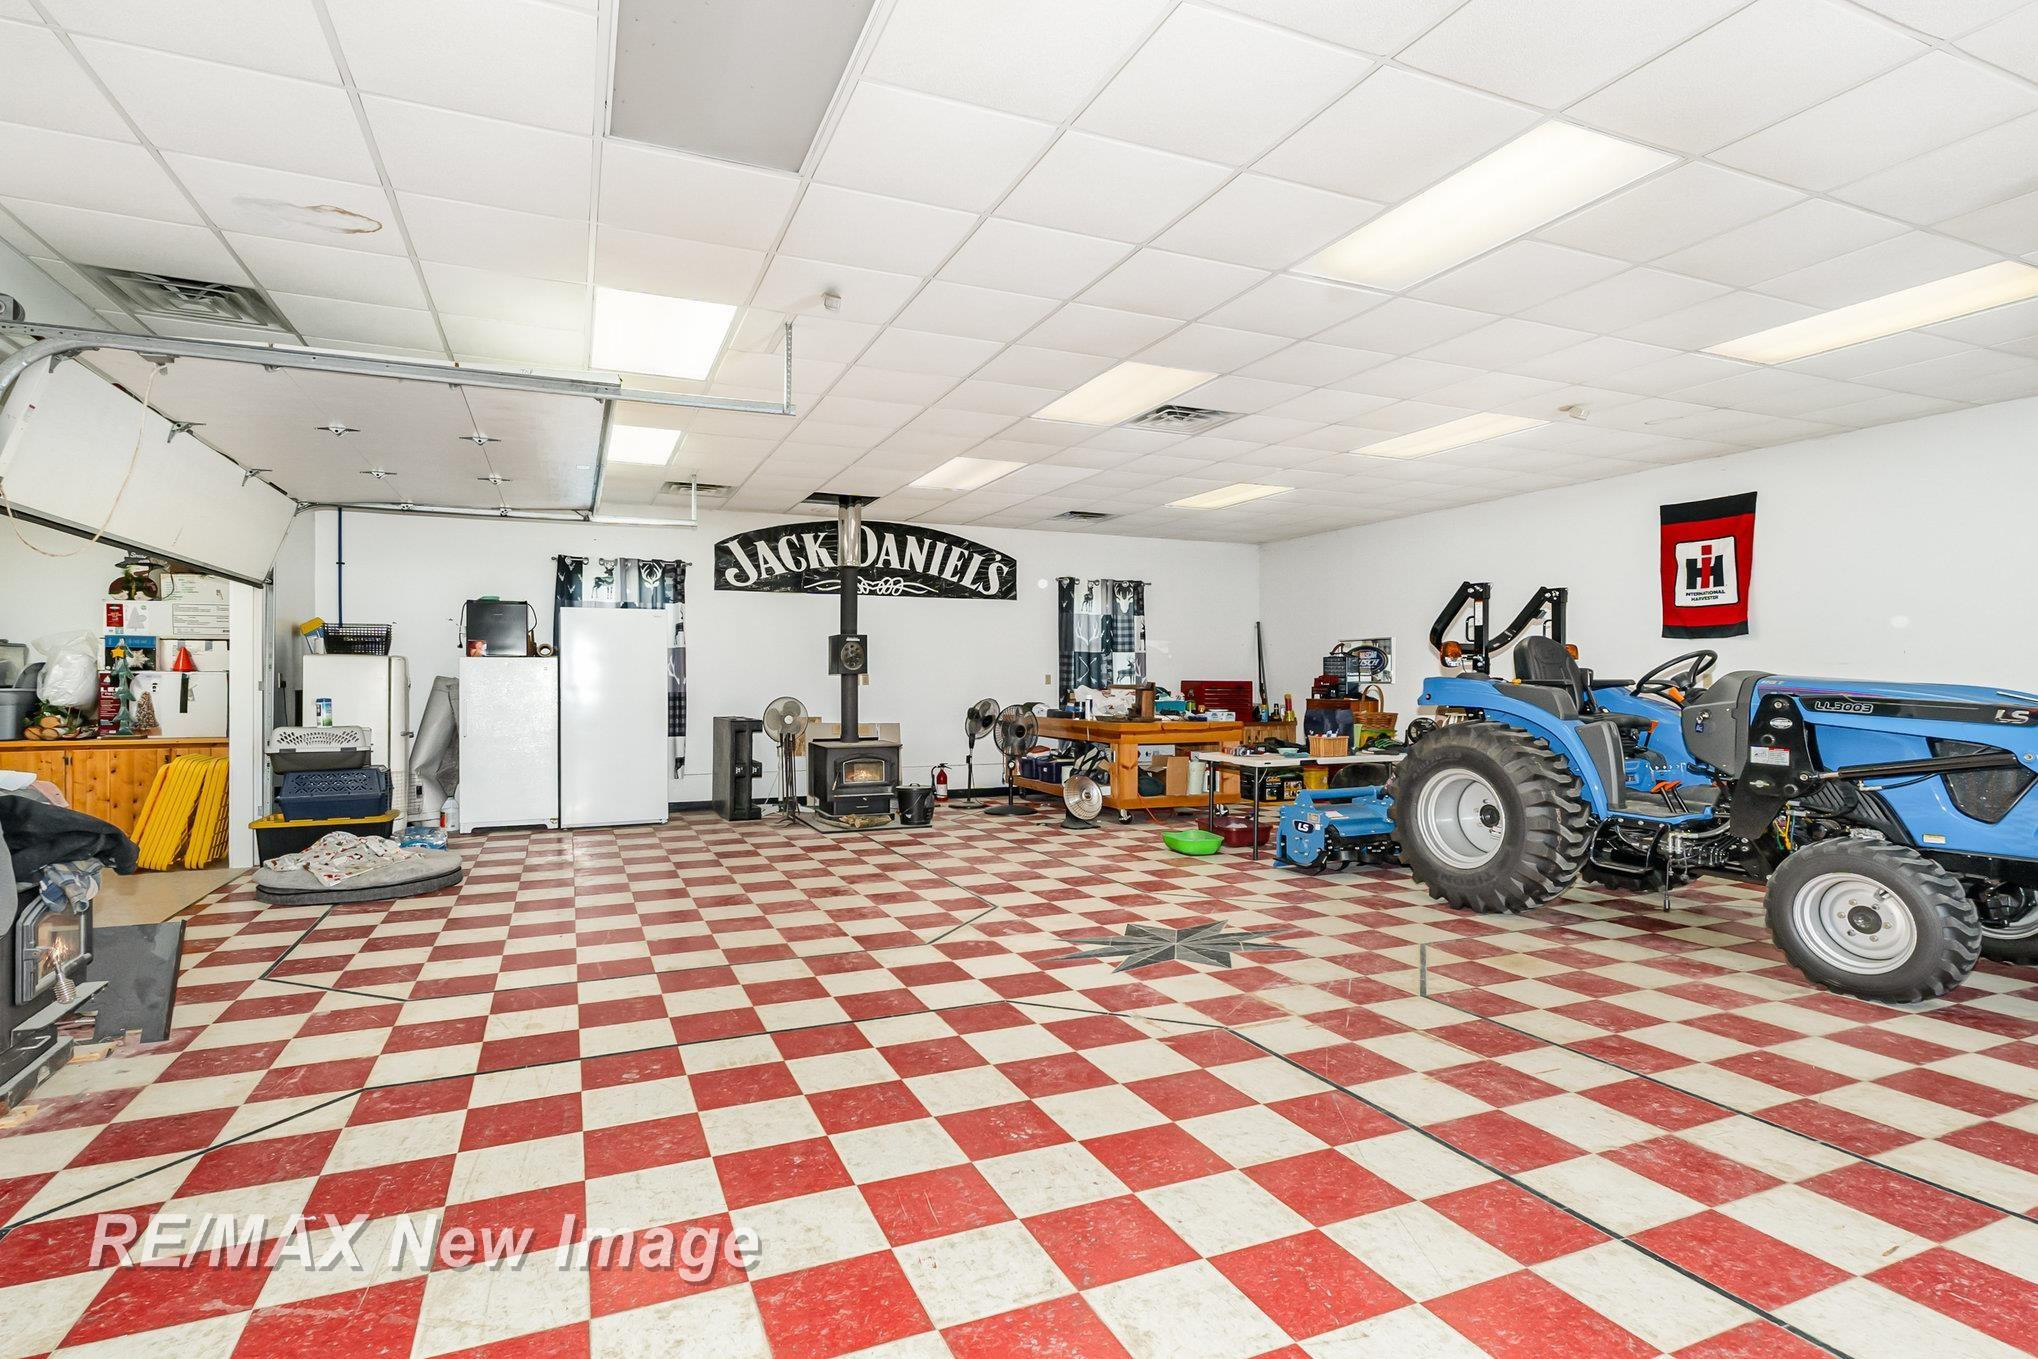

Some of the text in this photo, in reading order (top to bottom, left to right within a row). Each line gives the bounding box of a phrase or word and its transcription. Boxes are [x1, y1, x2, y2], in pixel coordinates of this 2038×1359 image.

[723, 525, 1010, 596] JACK DANIEL'S
[1685, 589, 1726, 597] INTERNATIONAL
[1814, 700, 1874, 714] LL3003
[1994, 709, 2030, 724] LS
[1297, 822, 1310, 832] LS
